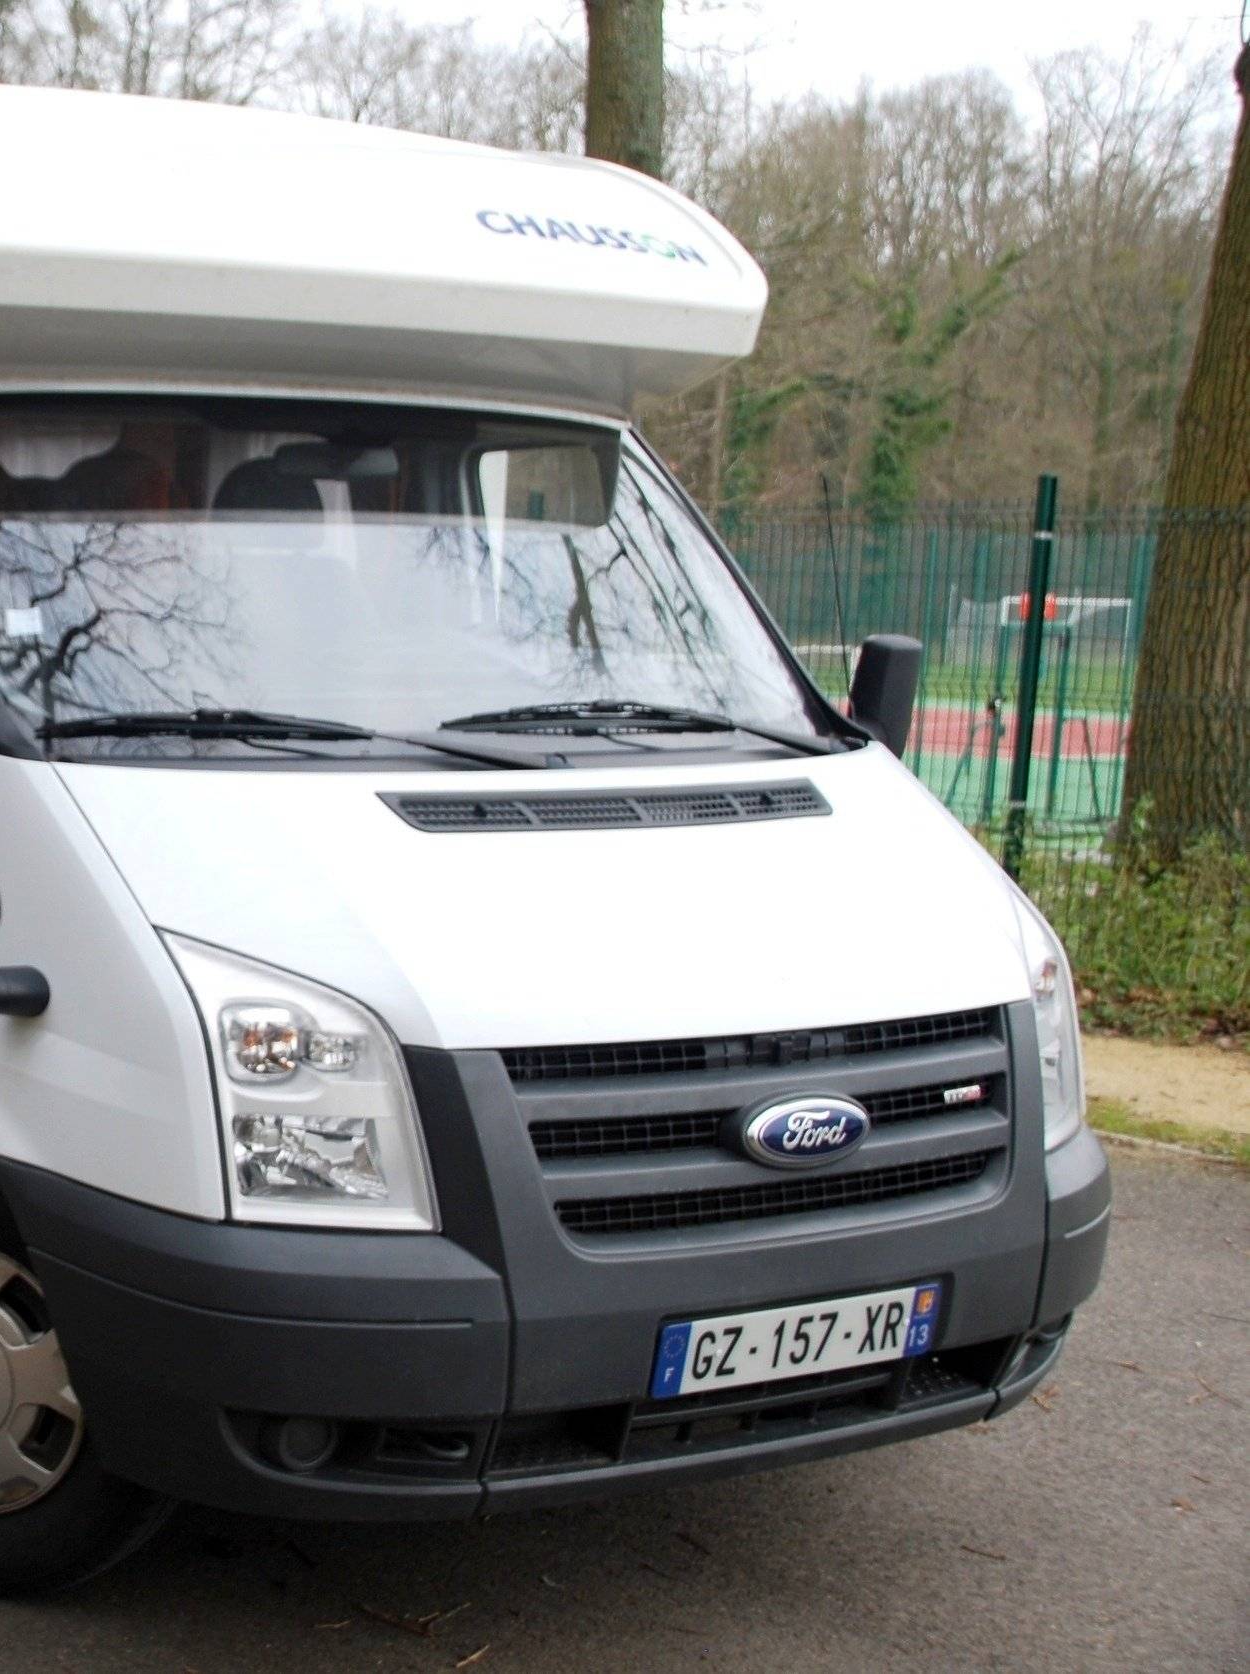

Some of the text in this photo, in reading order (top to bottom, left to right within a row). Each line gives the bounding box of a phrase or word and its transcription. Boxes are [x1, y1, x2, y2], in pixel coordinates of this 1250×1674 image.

[476, 209, 708, 266] CHAUSSON
[782, 1110, 846, 1150] Ford
[909, 1324, 929, 1347] 13
[664, 1366, 673, 1382] F
